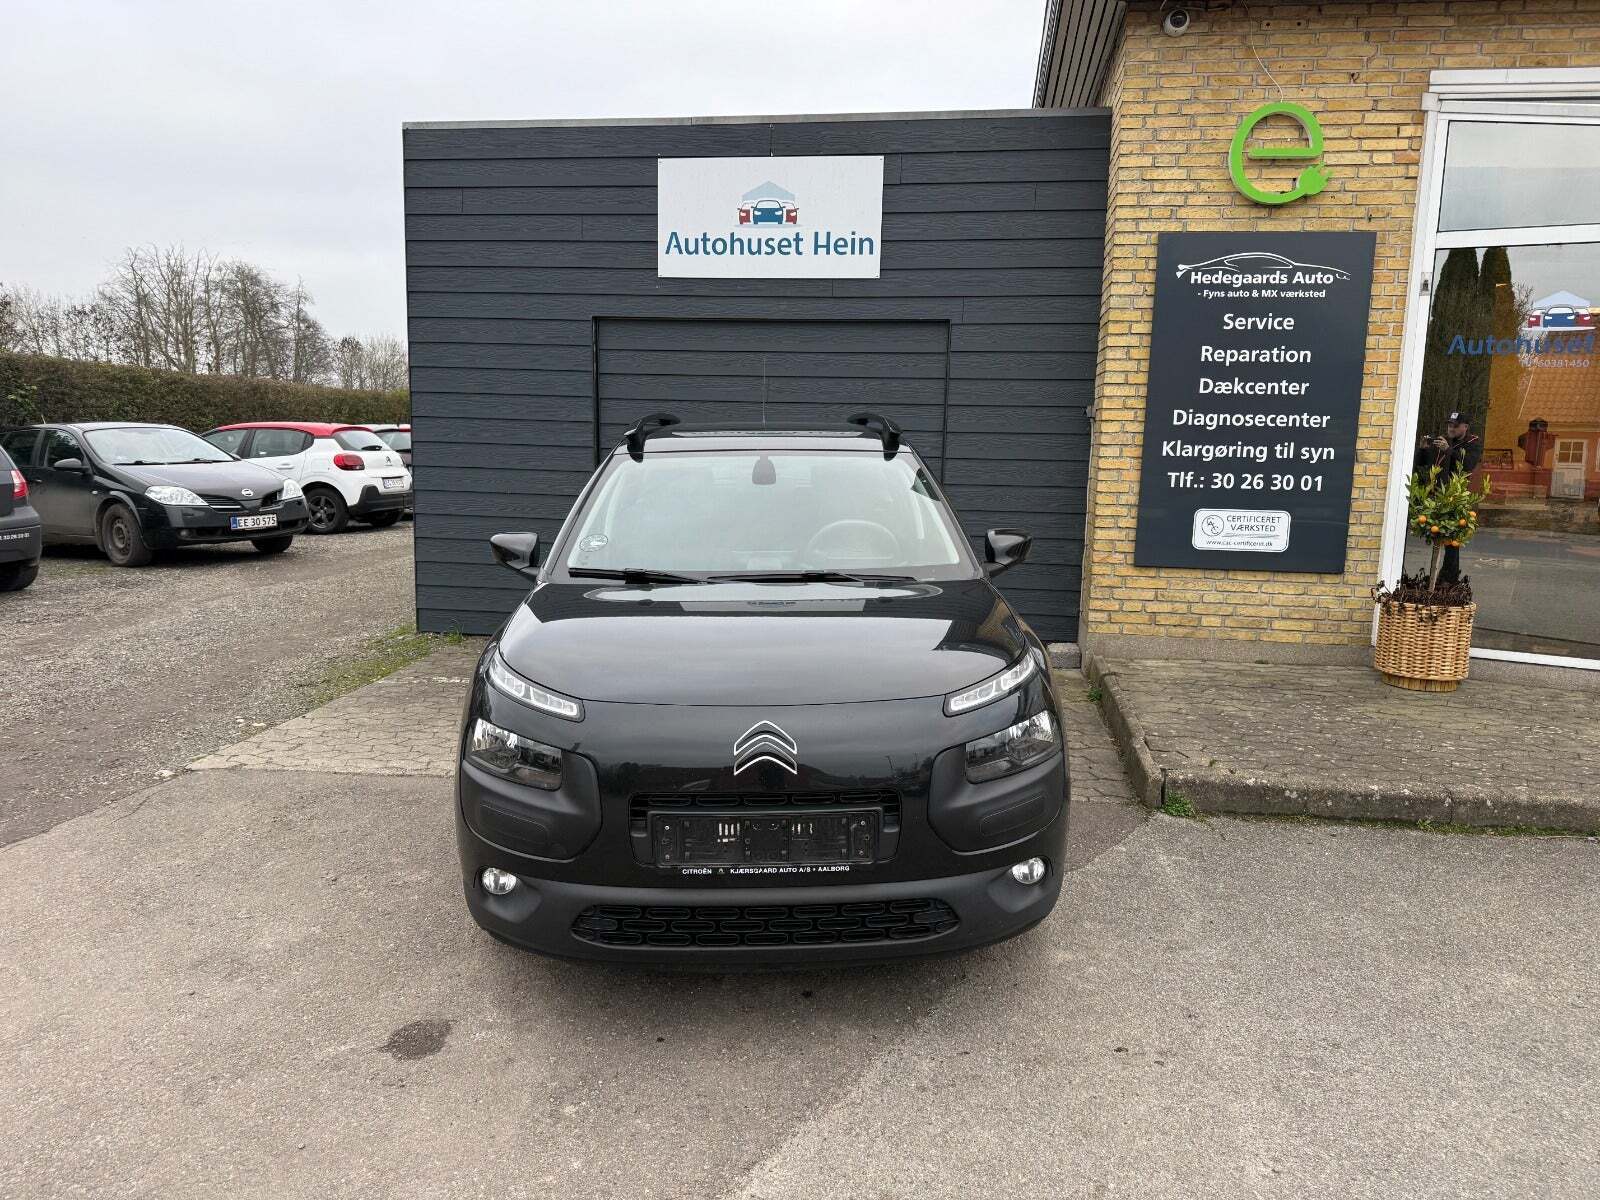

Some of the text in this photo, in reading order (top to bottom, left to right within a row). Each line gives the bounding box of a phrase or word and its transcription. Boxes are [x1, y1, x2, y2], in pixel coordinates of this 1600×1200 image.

[664, 231, 874, 256] Autohuset Hein
[1190, 270, 1334, 288] Hedegaards Auto
[1203, 289, 1226, 299] Fyns
[1227, 290, 1250, 298] auto
[1251, 289, 1260, 297] &
[1261, 289, 1278, 297] MX
[1280, 289, 1326, 298] værksted
[1223, 313, 1295, 330] Service
[1200, 345, 1312, 366] Reparation
[1199, 377, 1310, 395] Dækcenter
[1173, 409, 1331, 430] Diagnosecenter
[1162, 440, 1335, 464] Klargøring til syn
[1211, 473, 1235, 489] 30
[1240, 474, 1264, 490] 26
[1270, 474, 1295, 491] 30
[1300, 475, 1323, 491] 01
[251, 517, 260, 526] 30
[262, 516, 276, 525] 575
[1226, 515, 1282, 523] CERTIFICERET
[1230, 524, 1276, 532] VÆRKSTED
